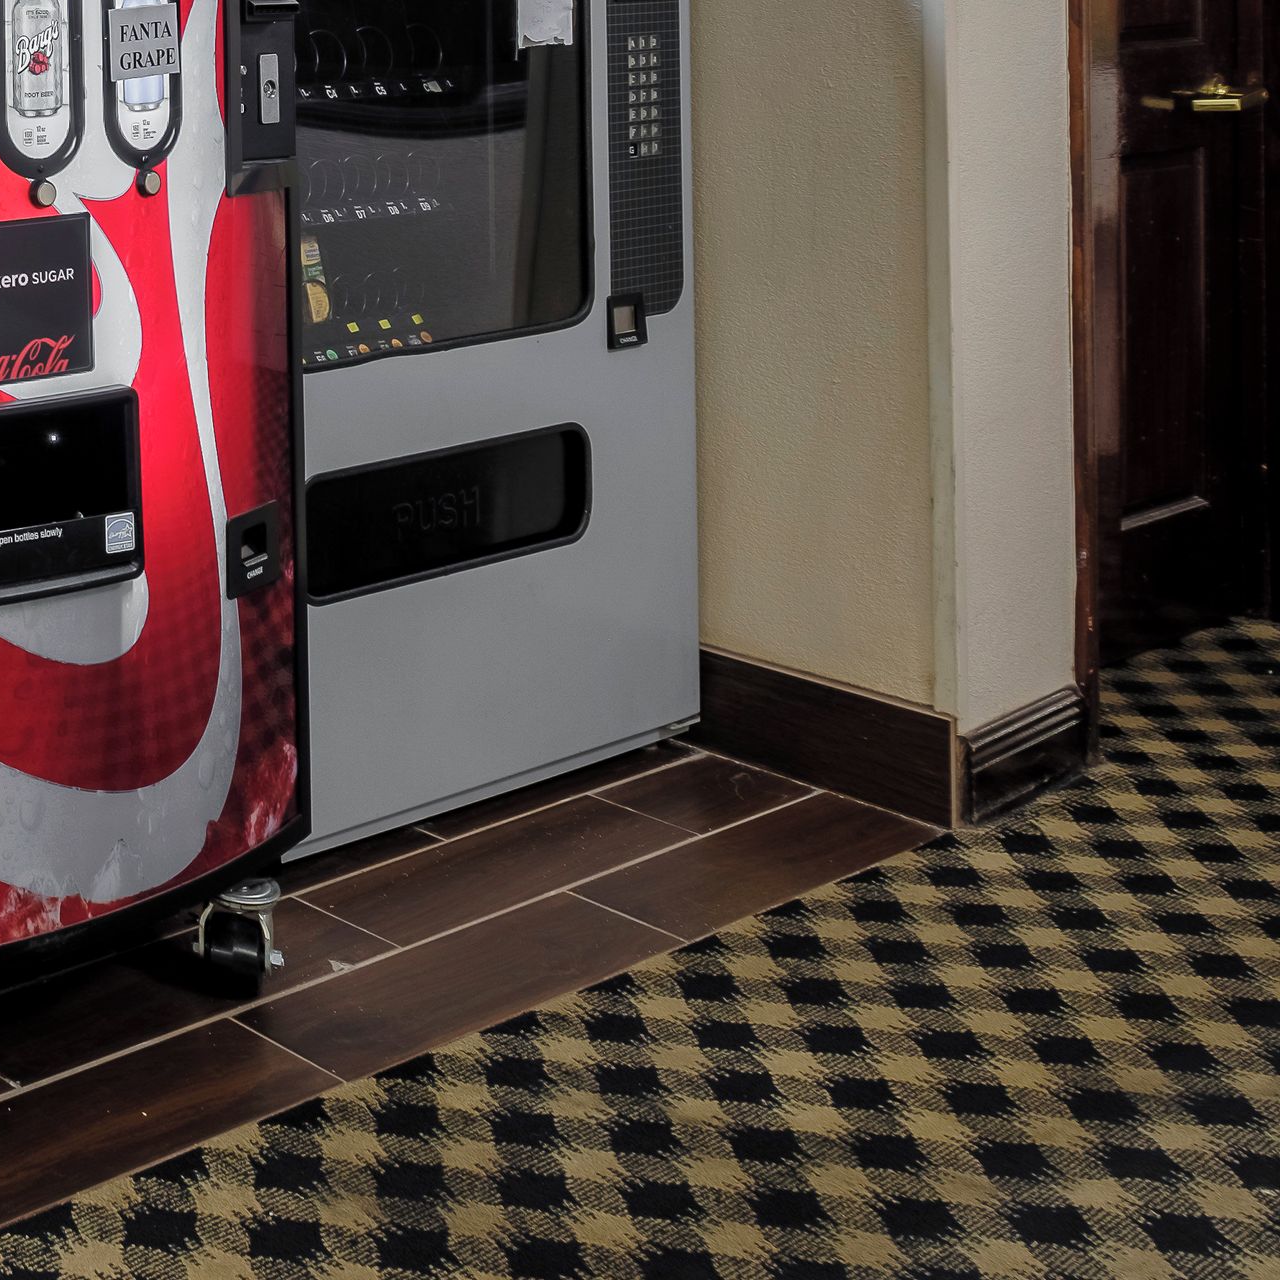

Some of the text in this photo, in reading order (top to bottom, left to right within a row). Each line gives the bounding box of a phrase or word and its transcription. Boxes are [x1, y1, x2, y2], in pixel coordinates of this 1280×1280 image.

[120, 20, 172, 43] FANTA
[15, 19, 60, 75] Barq's
[120, 47, 176, 70] GRAPE
[24, 91, 39, 99] ROOT
[31, 267, 75, 285] SUGAR
[391, 485, 480, 540] PUSH
[14, 531, 39, 543] bottles
[40, 527, 62, 538] slowly
